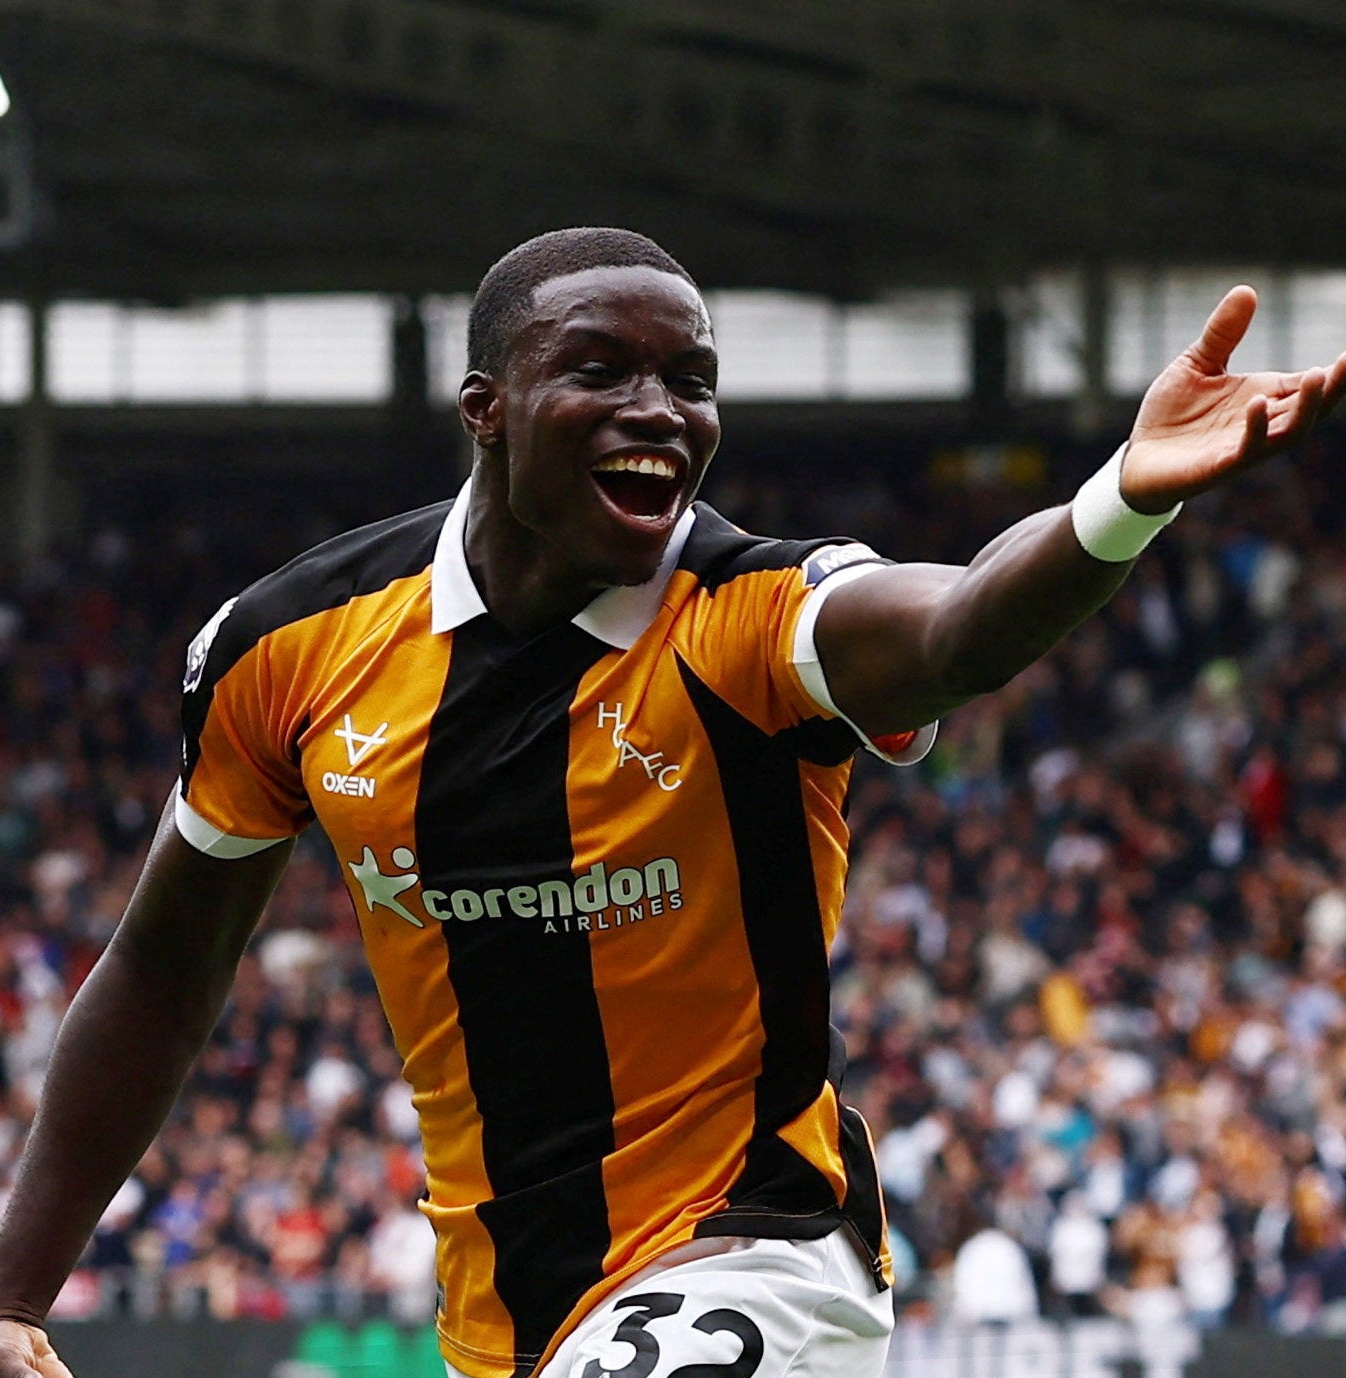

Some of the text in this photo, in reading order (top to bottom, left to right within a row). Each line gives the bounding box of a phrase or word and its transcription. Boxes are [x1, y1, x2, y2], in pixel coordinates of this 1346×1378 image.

[322, 771, 376, 799] OXEN
[421, 856, 681, 922] corendon
[544, 892, 684, 935] AIRLINES
